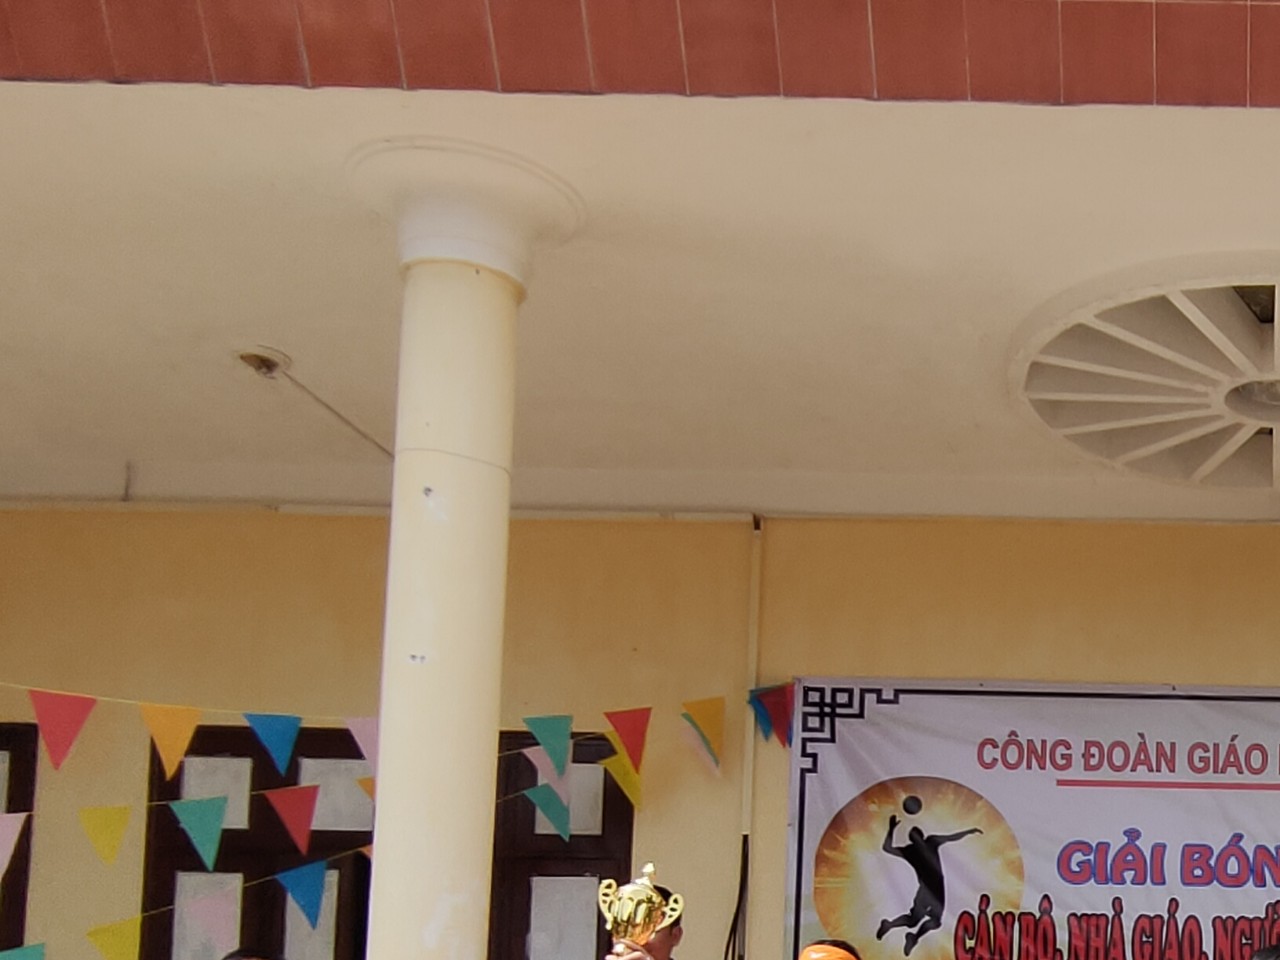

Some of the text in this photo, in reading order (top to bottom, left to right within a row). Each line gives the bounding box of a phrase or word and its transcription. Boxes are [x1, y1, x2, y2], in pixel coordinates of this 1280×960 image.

[977, 730, 1073, 772] CÔNG
[1082, 732, 1176, 773] ĐOÀN
[1187, 734, 1269, 775] GIÁO
[1057, 827, 1167, 886] GIẢI
